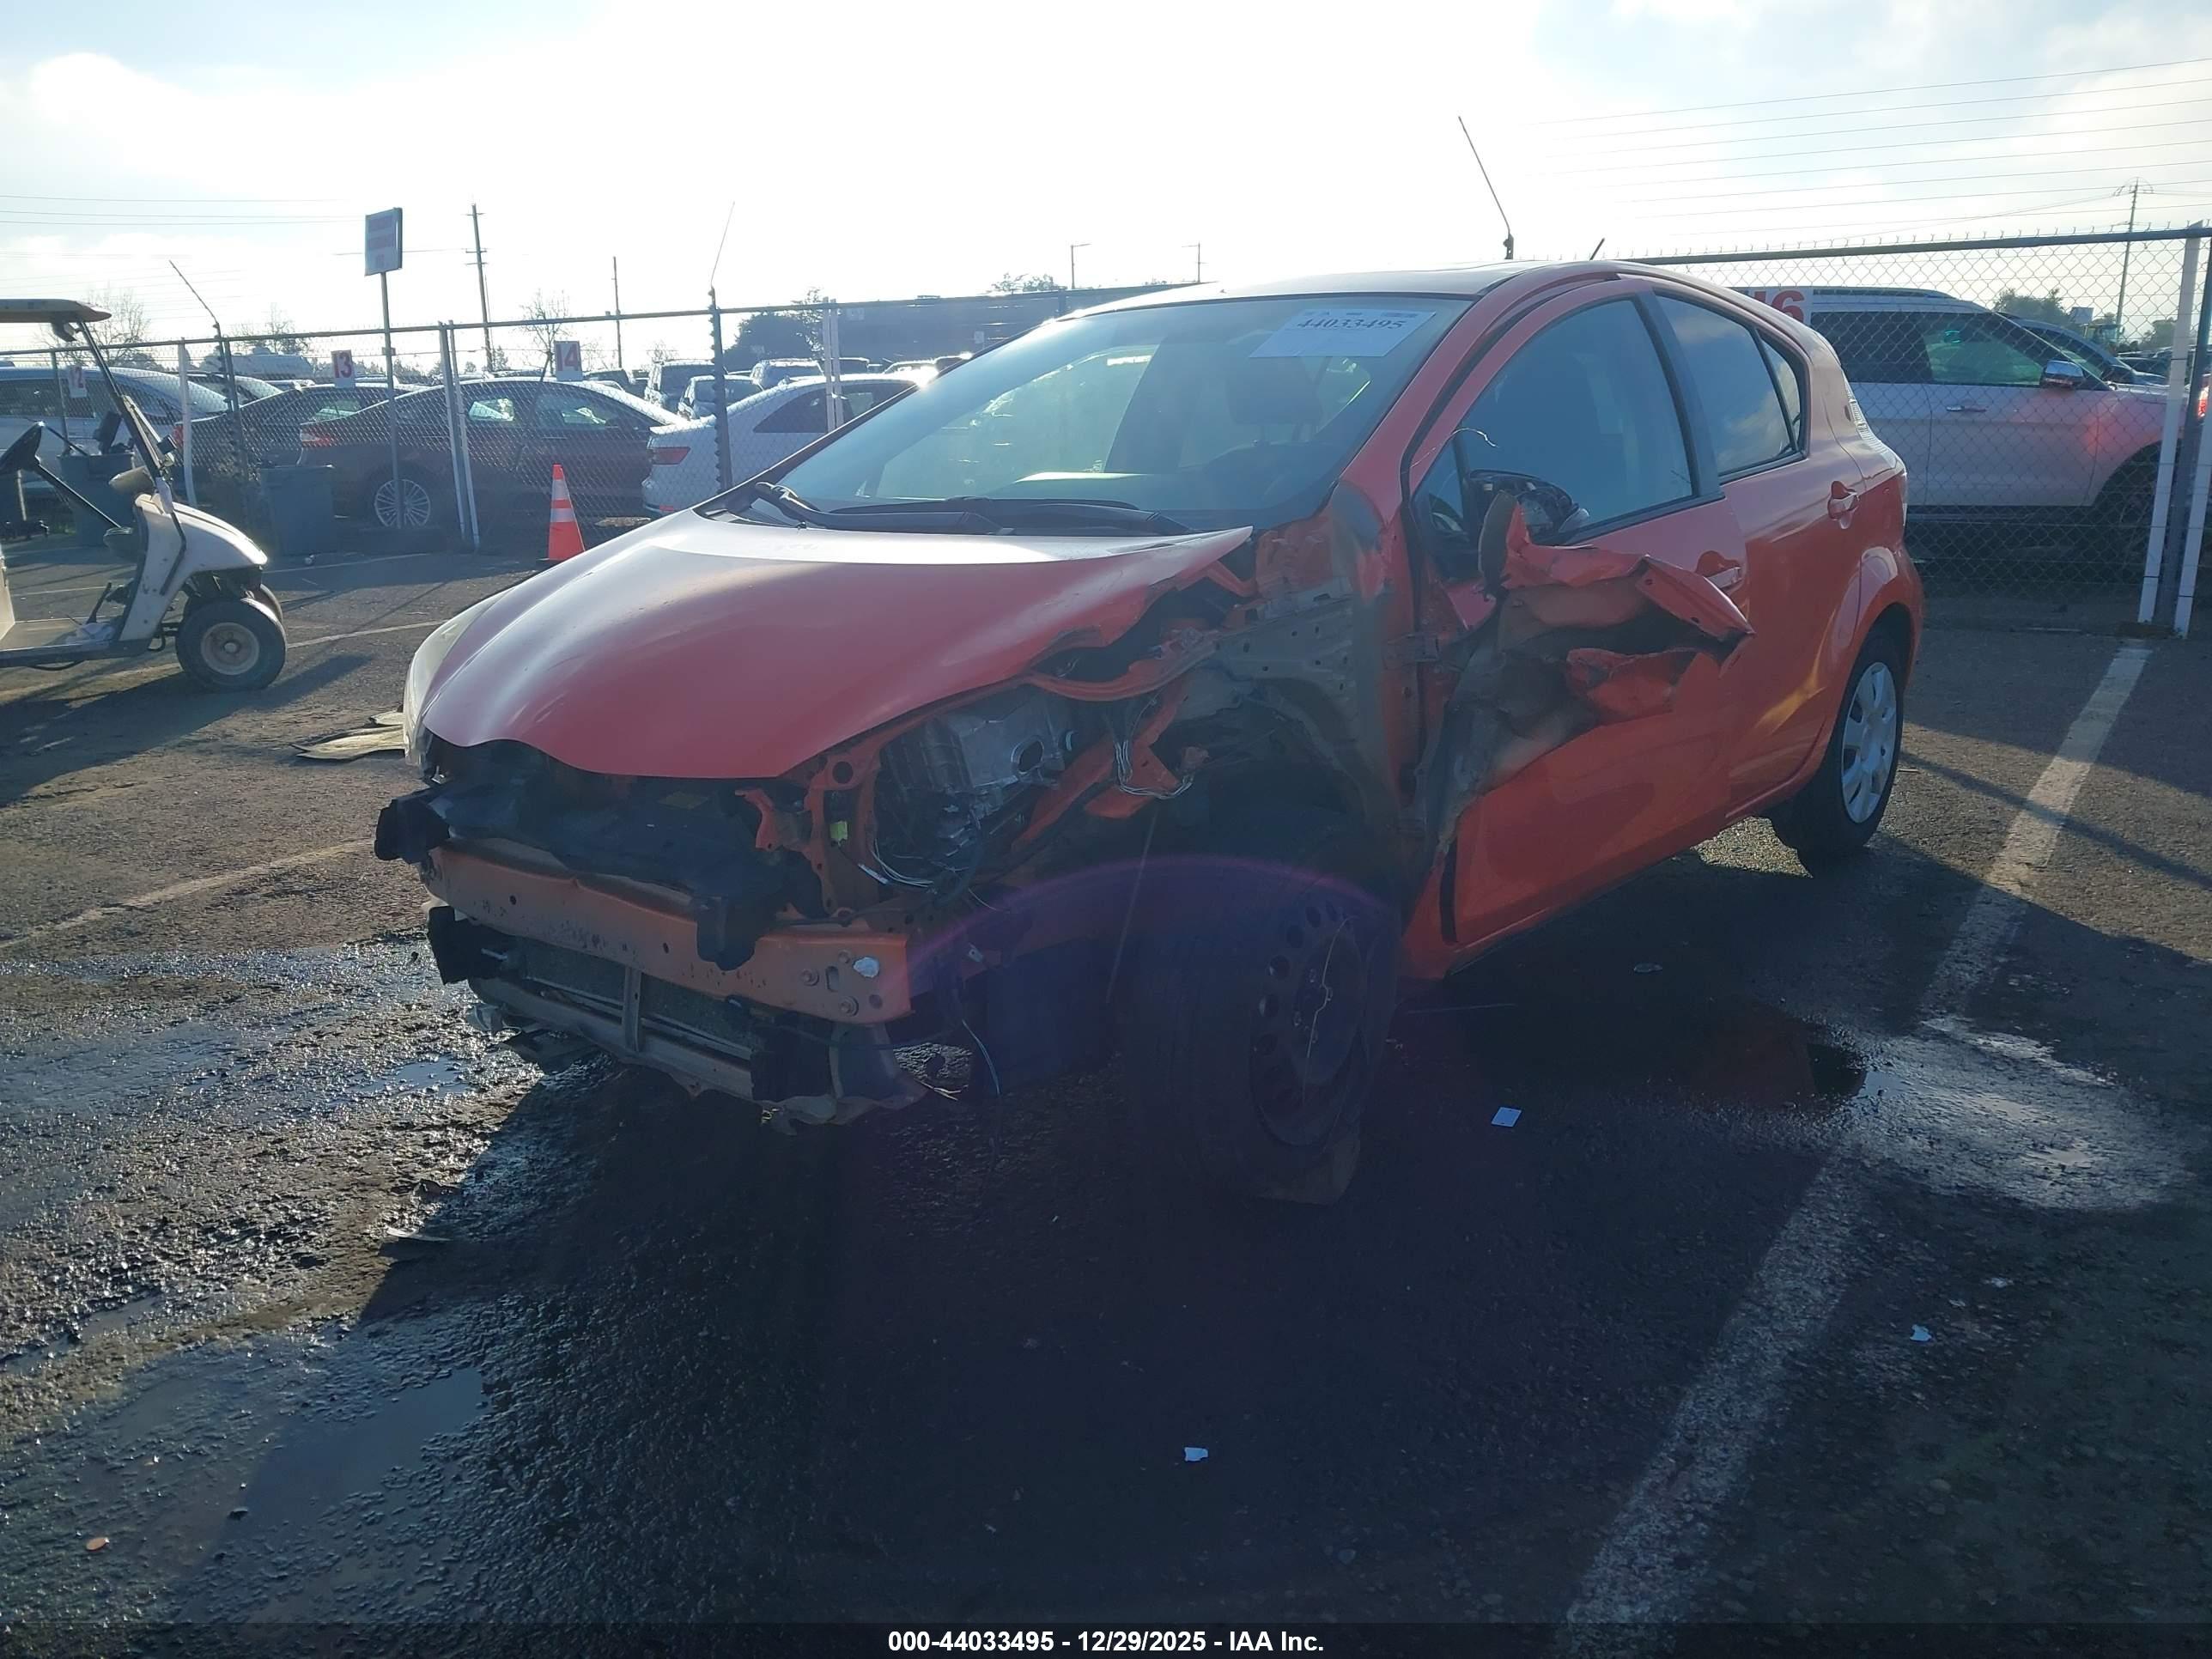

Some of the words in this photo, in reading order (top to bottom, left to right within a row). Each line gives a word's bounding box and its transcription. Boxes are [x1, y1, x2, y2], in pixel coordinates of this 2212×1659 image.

[1297, 318, 1407, 330] 44033495
[334, 351, 352, 378] 13
[556, 343, 579, 371] 14
